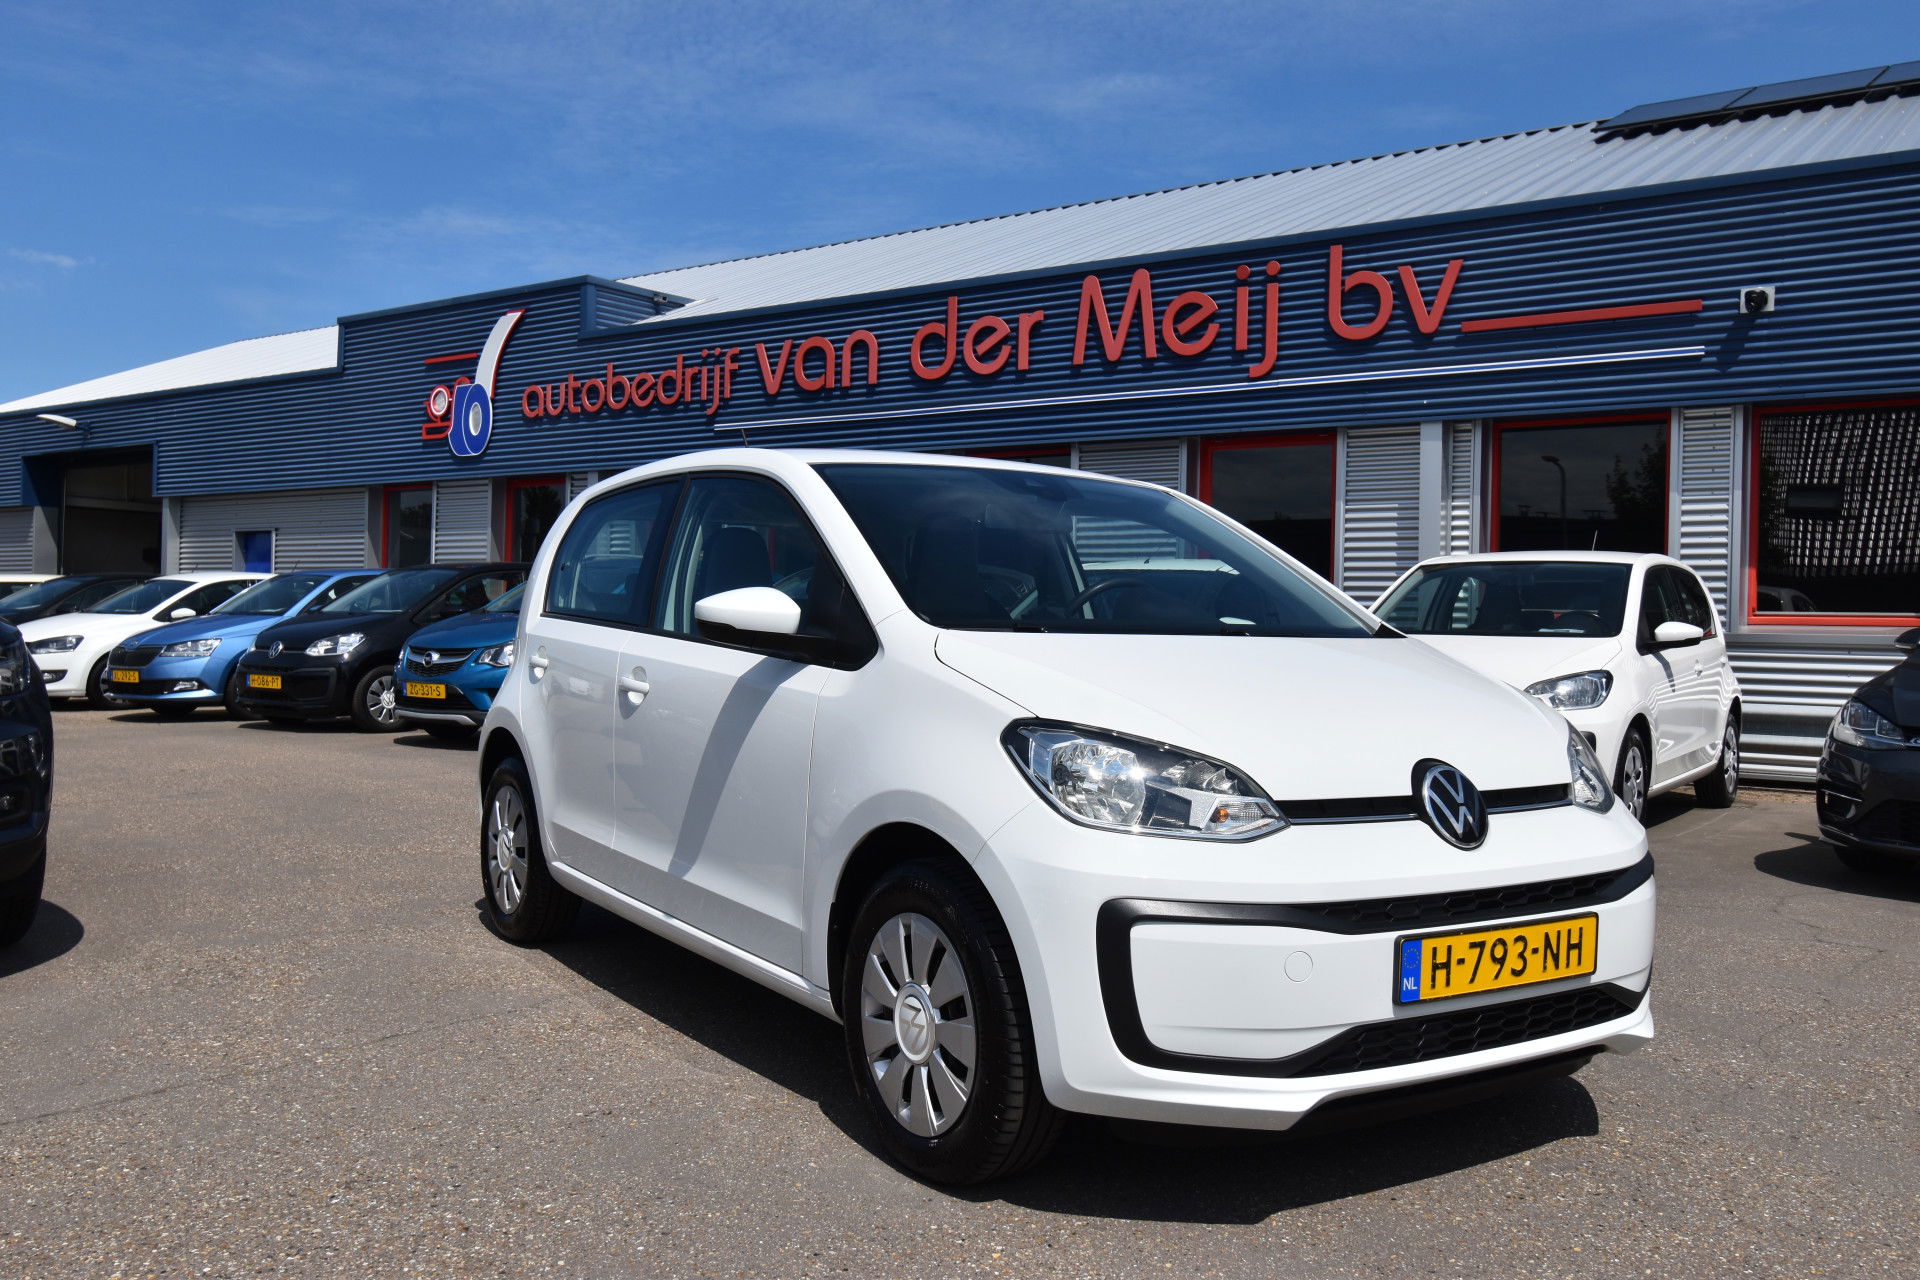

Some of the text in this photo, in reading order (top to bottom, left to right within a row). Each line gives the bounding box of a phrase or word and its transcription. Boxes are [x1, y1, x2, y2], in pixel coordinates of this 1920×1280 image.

[522, 244, 1464, 415] autobedrijf van der Meij bv
[408, 683, 441, 697] ZG-331-S
[1403, 926, 1584, 990] NL H-793-NH
